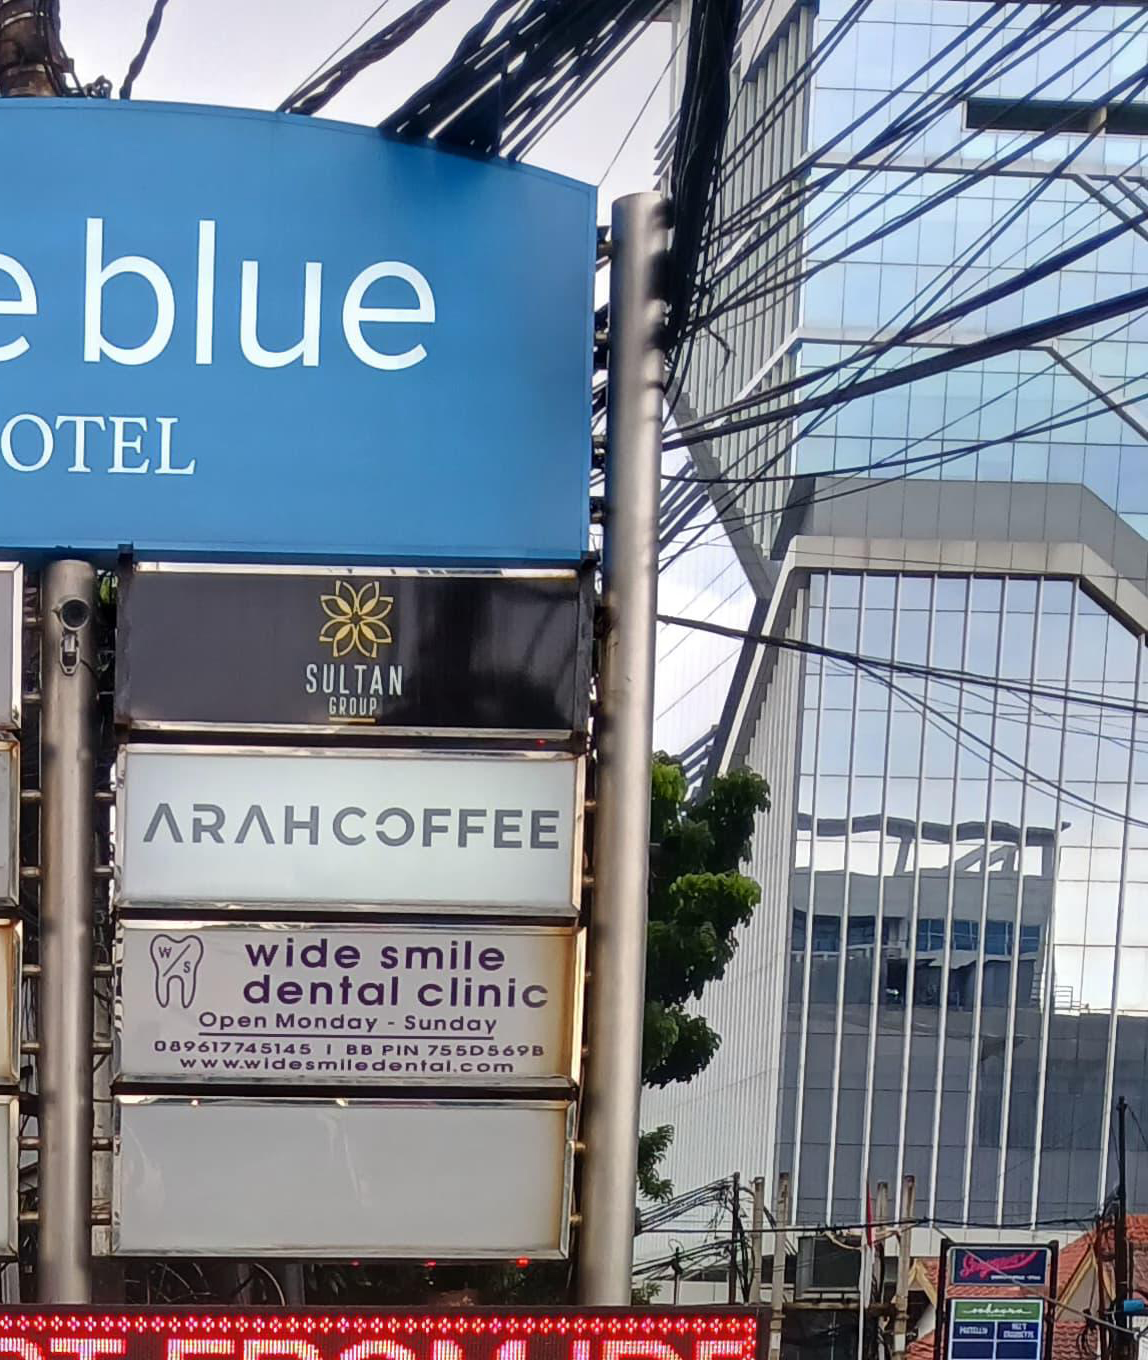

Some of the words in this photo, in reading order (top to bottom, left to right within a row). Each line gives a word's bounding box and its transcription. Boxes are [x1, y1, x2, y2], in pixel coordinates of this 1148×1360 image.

[83, 217, 436, 371] blue
[305, 664, 402, 697] SULTAN
[328, 697, 377, 716] GROUP
[245, 938, 361, 970] wide
[380, 941, 505, 971] smile
[243, 974, 399, 1006] dental
[417, 977, 549, 1009] clinic
[199, 1012, 266, 1032] Open
[276, 1013, 377, 1033] Monday
[405, 1015, 497, 1034] Sunday
[346, 1043, 373, 1056] BB
[382, 1044, 419, 1057] PIN
[180, 1057, 514, 1074] www.widesmiledental.com
